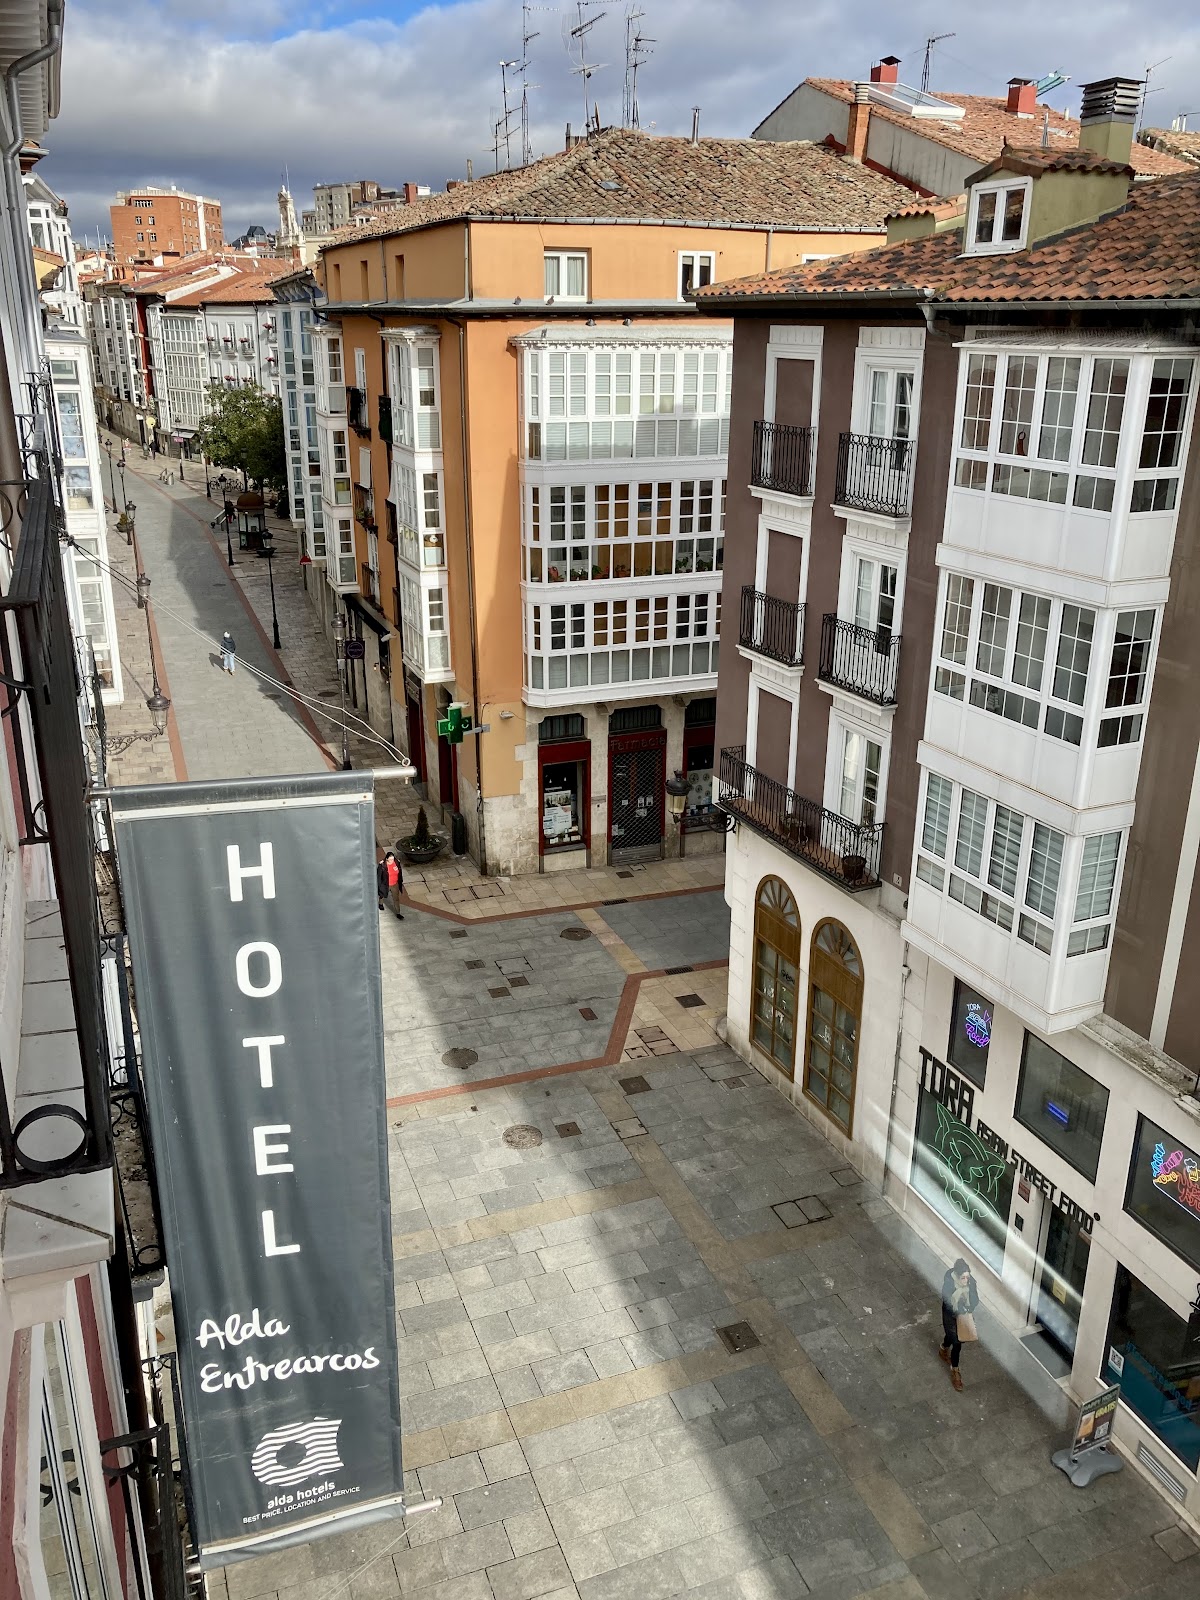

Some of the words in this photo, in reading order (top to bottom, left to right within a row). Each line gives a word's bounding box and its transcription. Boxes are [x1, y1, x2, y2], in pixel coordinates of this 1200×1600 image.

[610, 737, 666, 751] Farmacia
[226, 841, 301, 1258] HOTEL
[918, 1045, 975, 1128] TORA
[977, 1119, 1009, 1160] ASIAN
[1011, 1149, 1058, 1202] STREET
[1059, 1191, 1094, 1235] FOOD
[195, 1307, 291, 1350] Alda
[199, 1346, 380, 1393] Entrearcos
[242, 1513, 260, 1524] BEST
[284, 1498, 316, 1513] LOCATION
[317, 1493, 332, 1504] AND
[332, 1486, 361, 1498] SERVICE
[267, 1496, 294, 1509] alda
[297, 1481, 336, 1500] hotels
